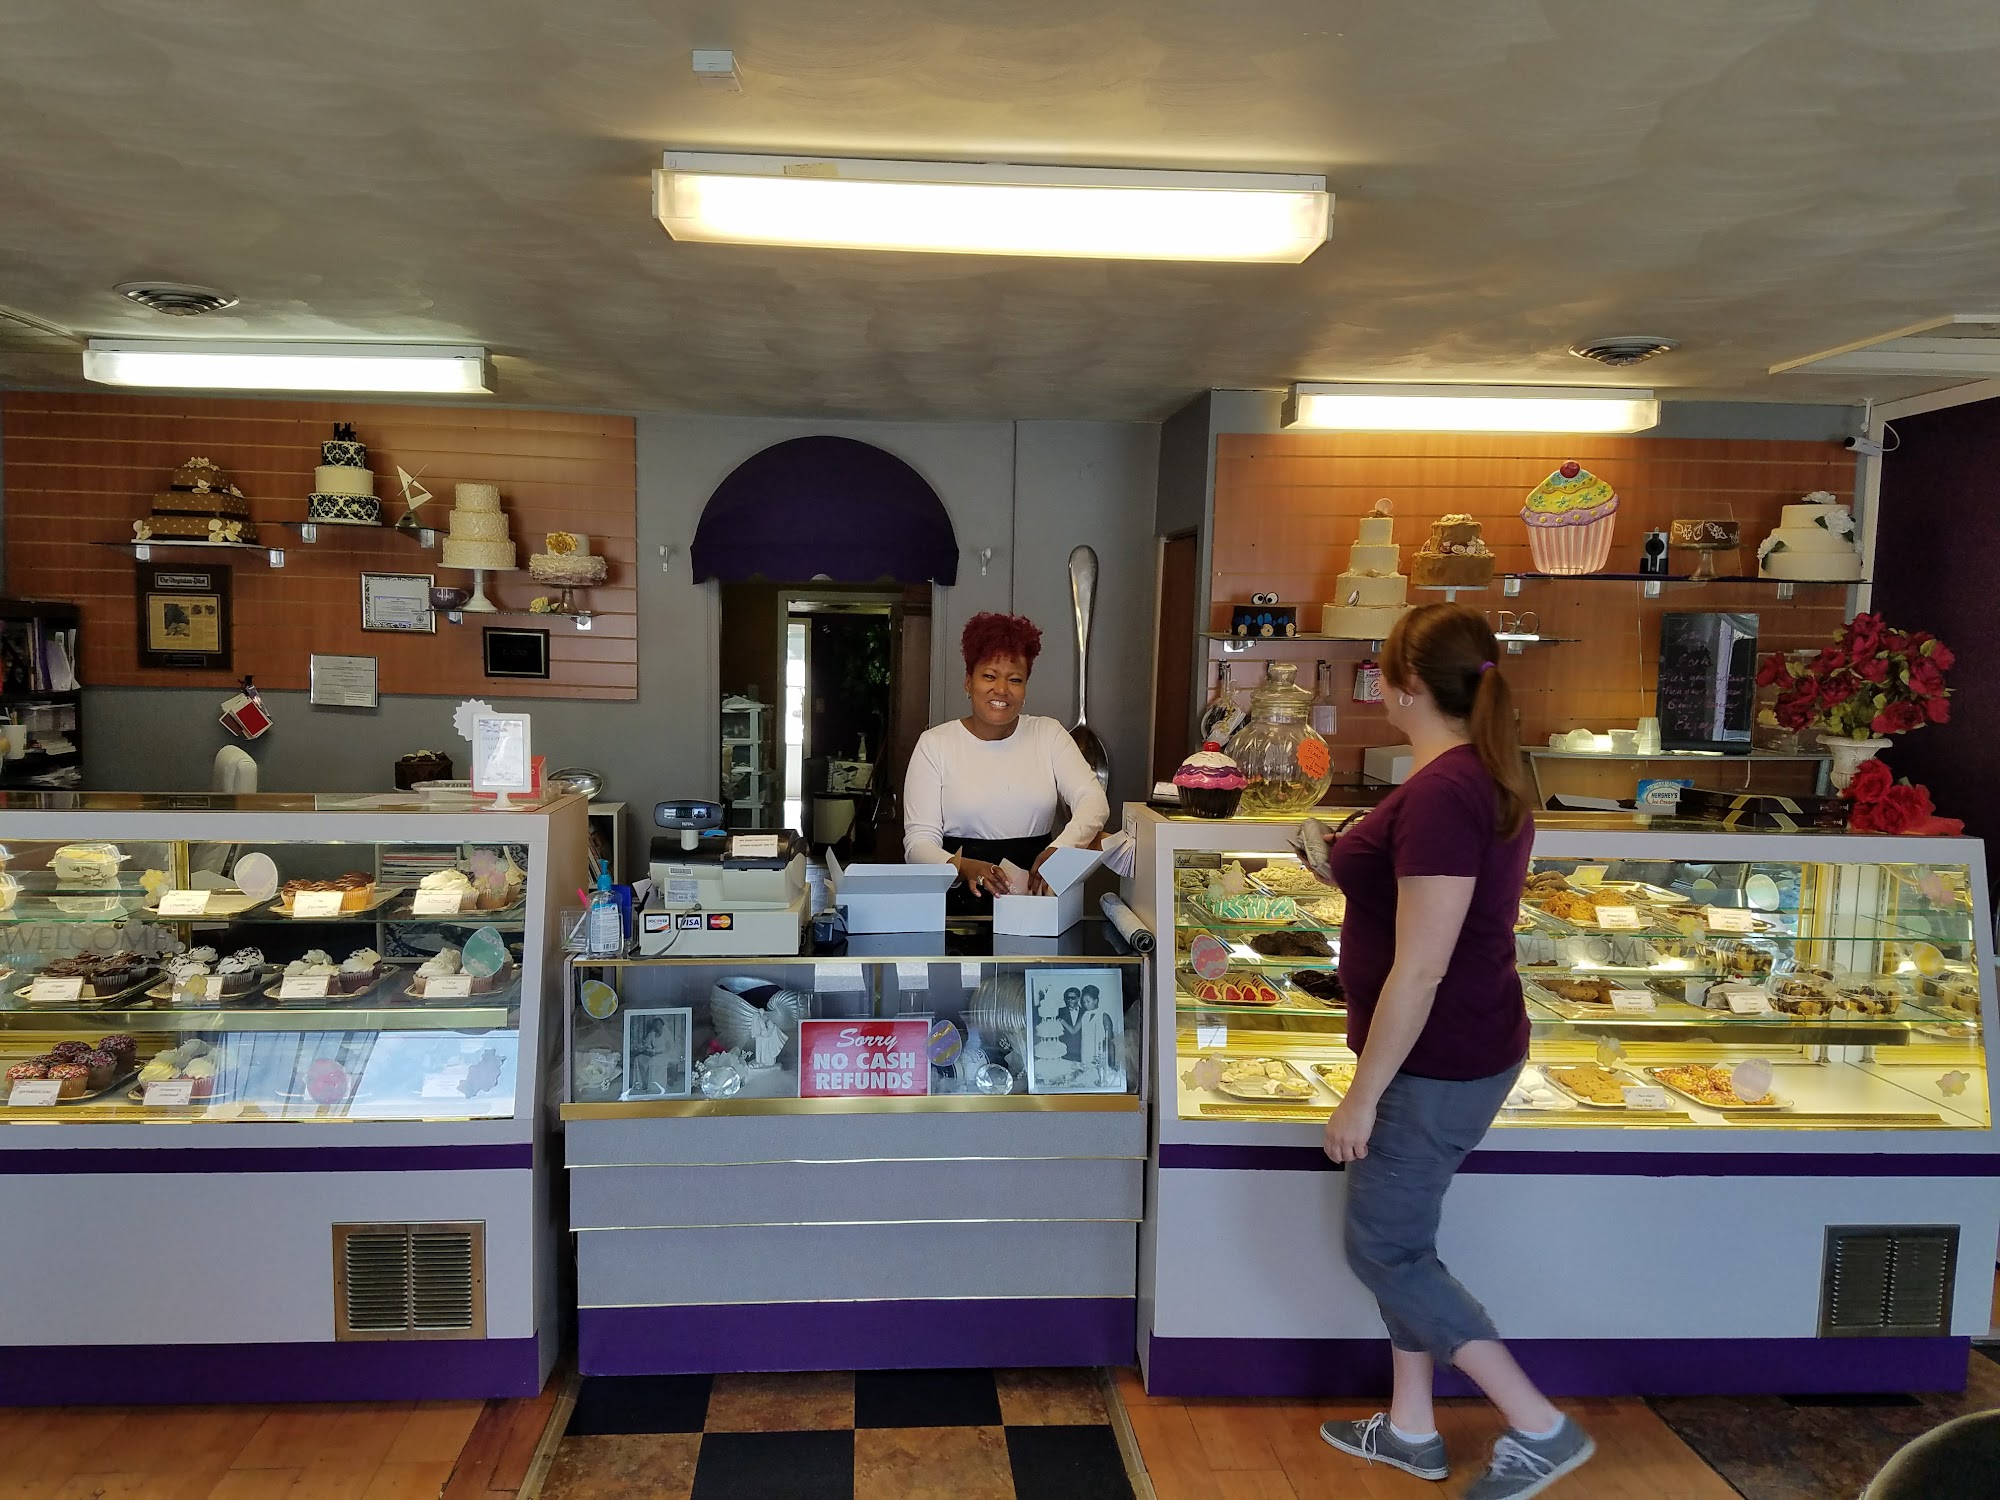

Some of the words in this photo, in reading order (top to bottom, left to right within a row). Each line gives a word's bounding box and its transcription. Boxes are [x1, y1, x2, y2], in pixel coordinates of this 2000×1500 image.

[1, 926, 169, 950] WELCOME
[836, 1028, 899, 1052] Sorry
[813, 1052, 849, 1070] NO
[856, 1052, 916, 1070] CASH
[815, 1071, 913, 1090] REFUNDS
